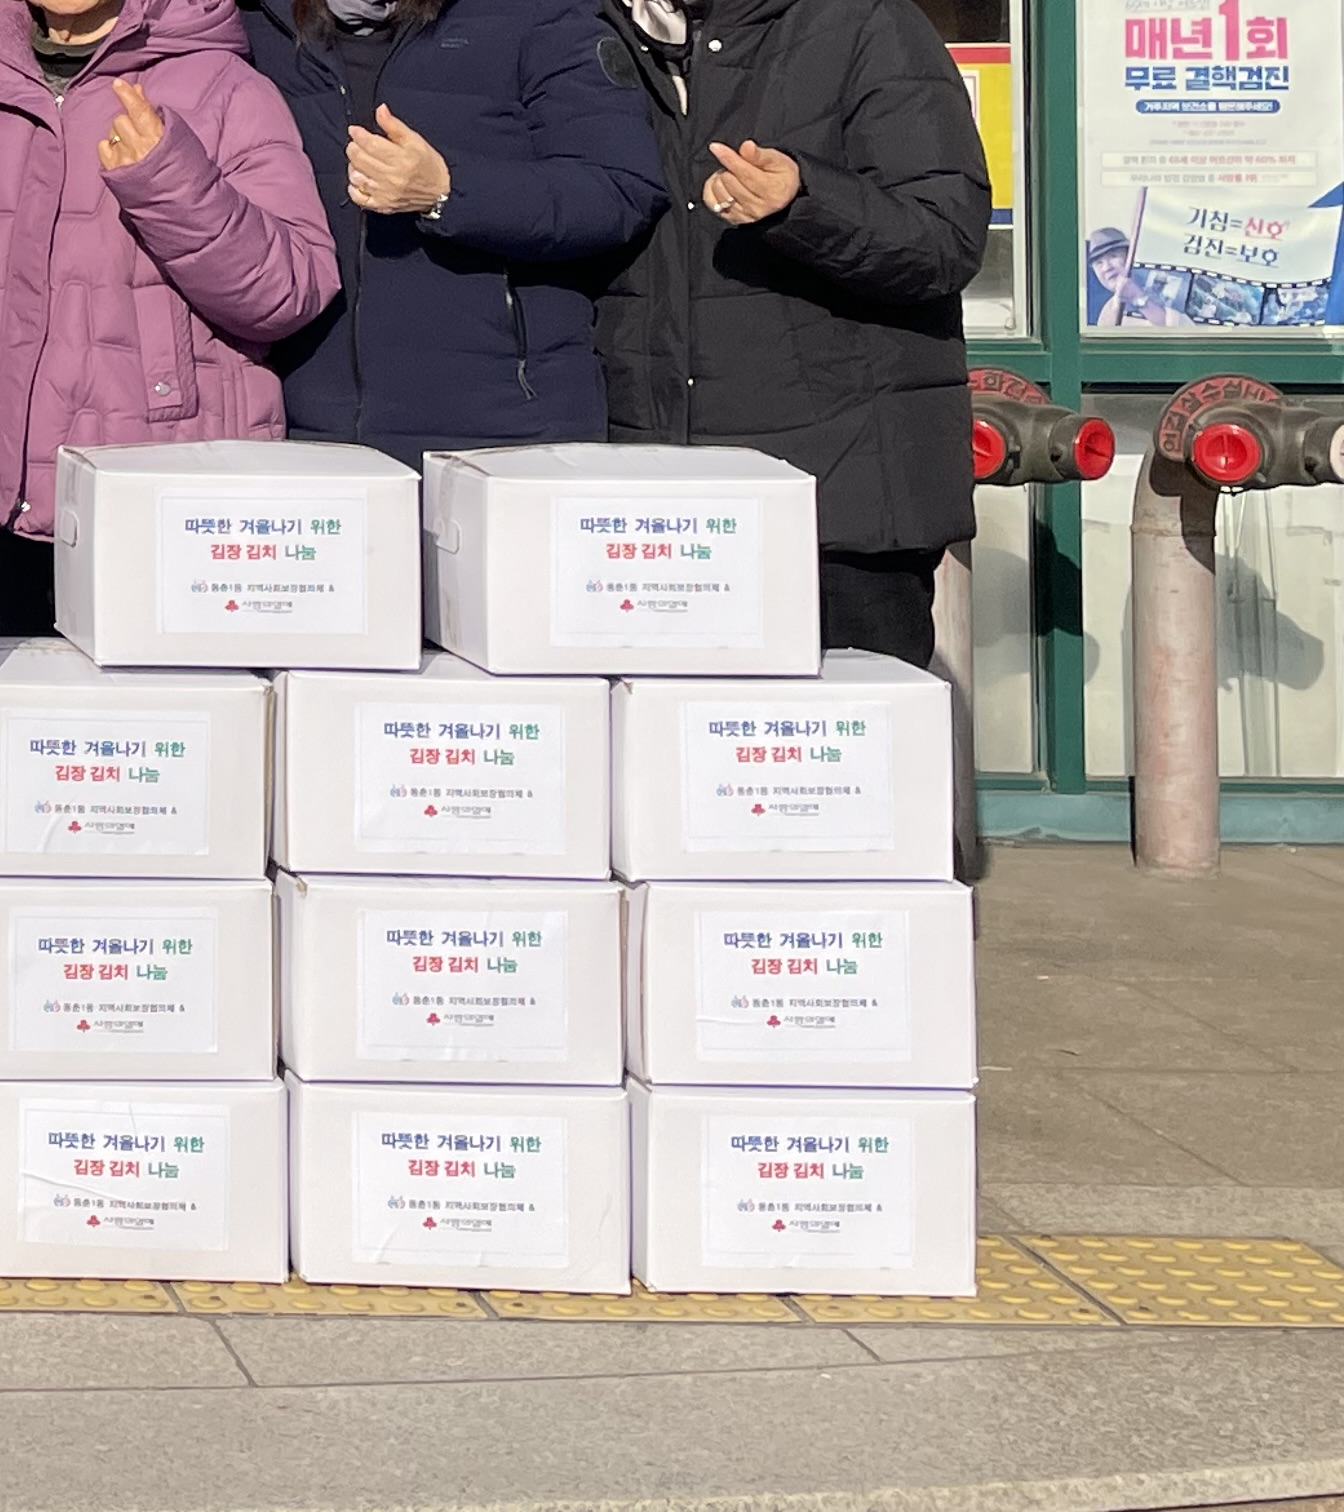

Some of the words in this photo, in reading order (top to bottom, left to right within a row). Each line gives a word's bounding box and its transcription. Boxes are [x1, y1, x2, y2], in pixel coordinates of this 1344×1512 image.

[1125, 17, 1213, 61] 매년
[1124, 65, 1178, 91] 무료
[1185, 65, 1290, 91] 결핵검진
[1186, 206, 1284, 239] 기침=신호
[1183, 233, 1280, 267] 검진=보호
[708, 720, 757, 737] 따뜻한
[764, 720, 827, 737] 겨울나기
[835, 720, 866, 737] 위한
[735, 746, 767, 764] 김장
[771, 746, 802, 764] 김치
[810, 746, 842, 763] 나눔
